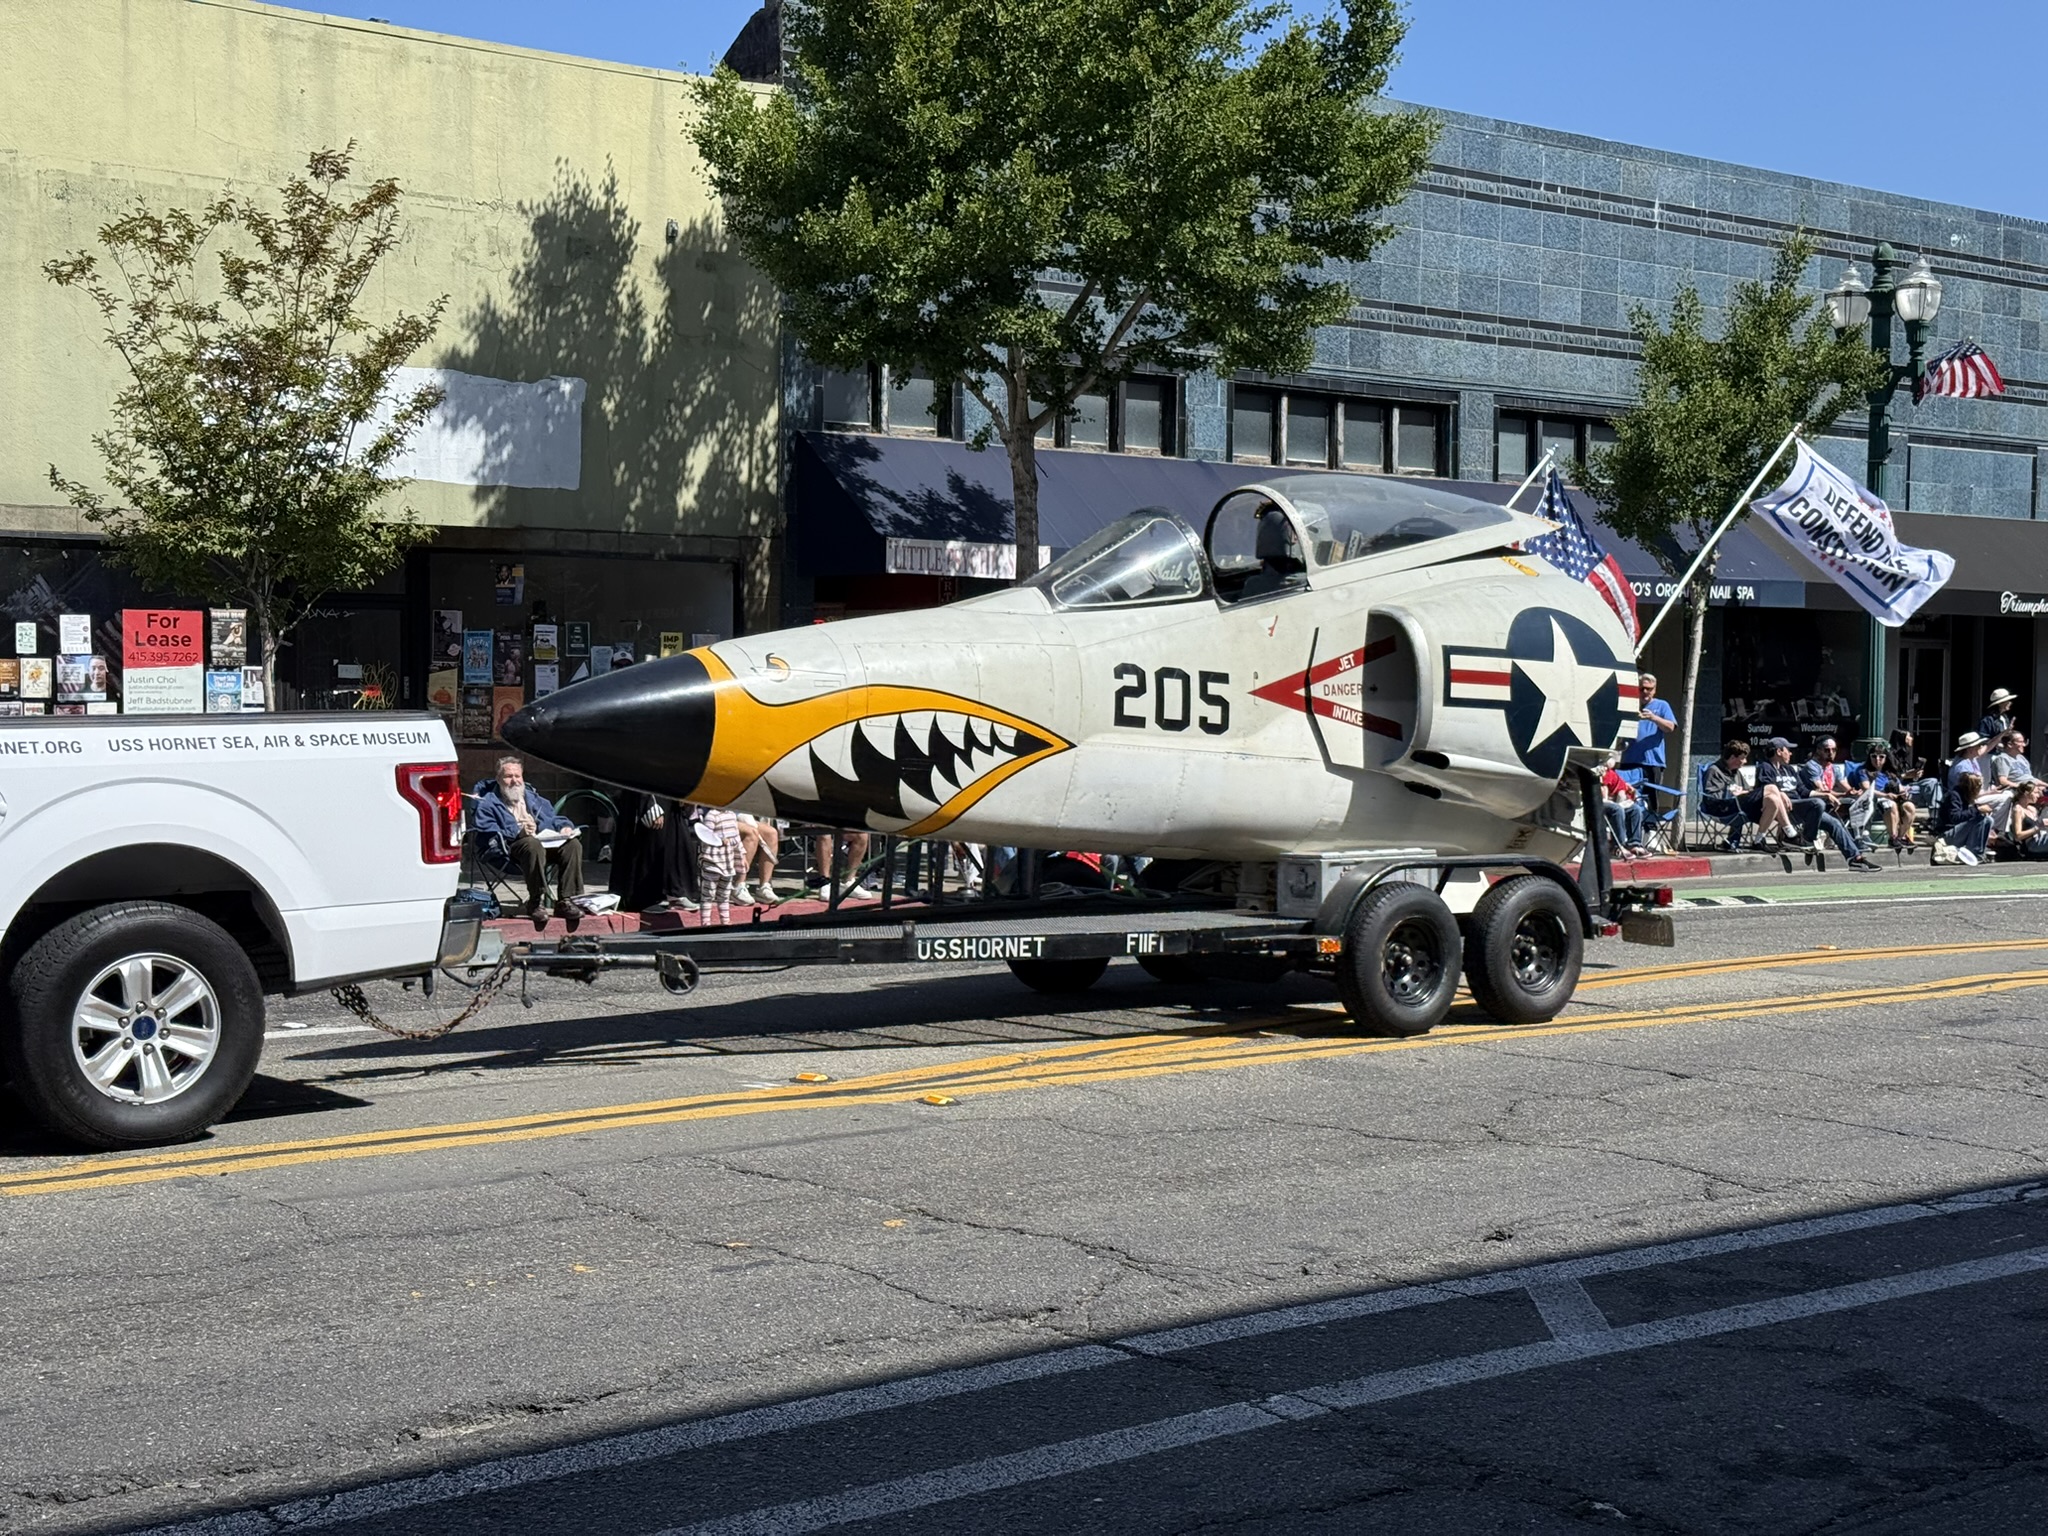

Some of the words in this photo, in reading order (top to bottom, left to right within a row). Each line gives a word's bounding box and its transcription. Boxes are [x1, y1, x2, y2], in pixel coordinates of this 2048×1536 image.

[1823, 486, 1885, 553] DEFEND
[894, 545, 943, 572] LITTLE
[1187, 560, 1201, 586] Sp
[1630, 582, 1652, 597] O'S
[1709, 585, 1732, 600] NAIL
[1736, 586, 1755, 600] SPA
[147, 613, 180, 629] For
[135, 631, 192, 647] Lease
[663, 635, 680, 643] IMP
[128, 652, 199, 662] 415.395.7262
[1338, 653, 1355, 671] JET
[128, 676, 154, 684] Justin
[156, 676, 177, 684] Choi
[1323, 684, 1364, 696] DANGER
[127, 697, 143, 705] Jeff
[145, 697, 193, 705] Badstubner
[1113, 662, 1230, 735] 205
[1332, 705, 1364, 726] INTAKE
[1747, 723, 1773, 735] Sunday
[1801, 723, 1838, 734] Wednesday
[108, 739, 144, 752] USS
[149, 737, 216, 751] HORNET
[223, 736, 259, 750] SEA,
[264, 735, 290, 748] AIR
[295, 734, 305, 747] &
[310, 733, 360, 746] SPACE
[362, 732, 431, 746] MUSEUM
[1750, 738, 1758, 746] 10
